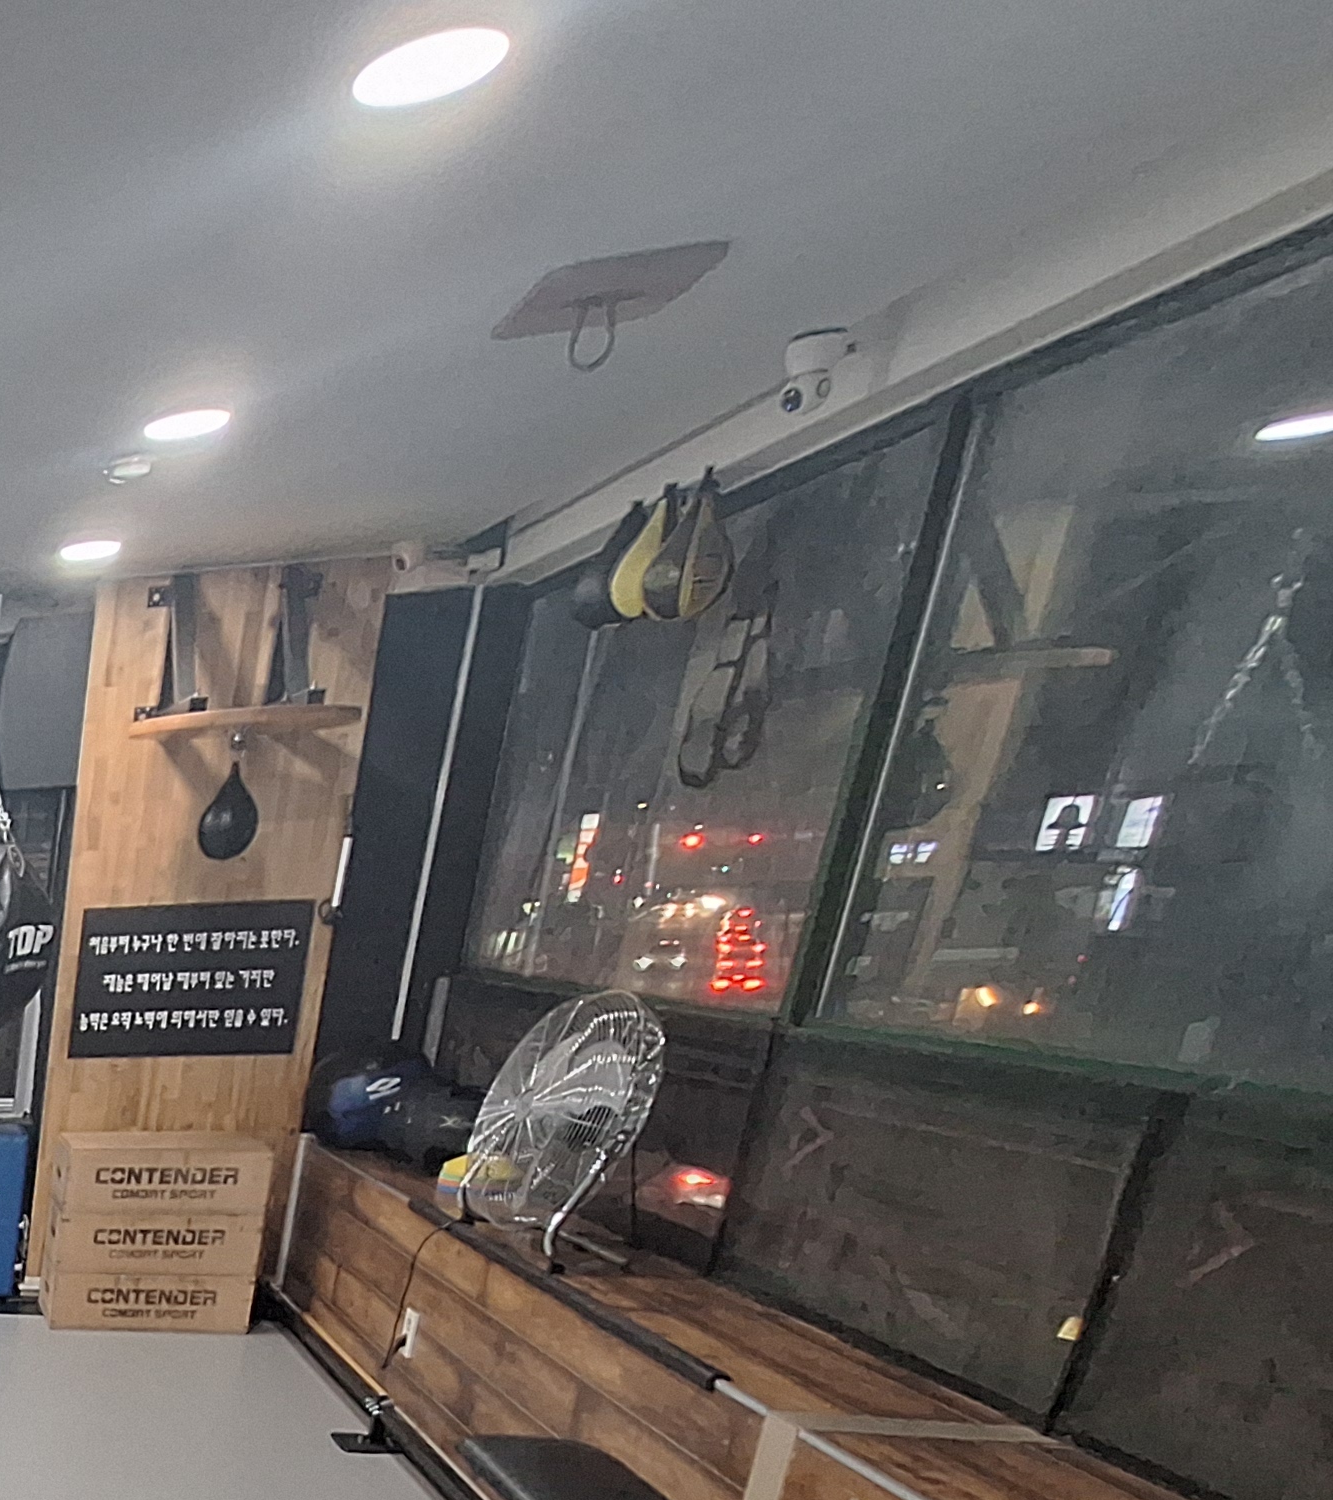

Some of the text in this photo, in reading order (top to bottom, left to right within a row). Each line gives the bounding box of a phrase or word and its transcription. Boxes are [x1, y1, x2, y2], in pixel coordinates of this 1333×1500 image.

[7, 924, 54, 959] TOP
[133, 934, 163, 953] 누구나
[166, 933, 179, 952] 한
[182, 932, 208, 951] 번에
[110, 1011, 132, 1031] 오직
[246, 1008, 257, 1026] 수
[95, 1167, 239, 1185] CONTENDER
[93, 1229, 226, 1245] CONTENDER
[87, 1288, 217, 1306] CONTENDER
